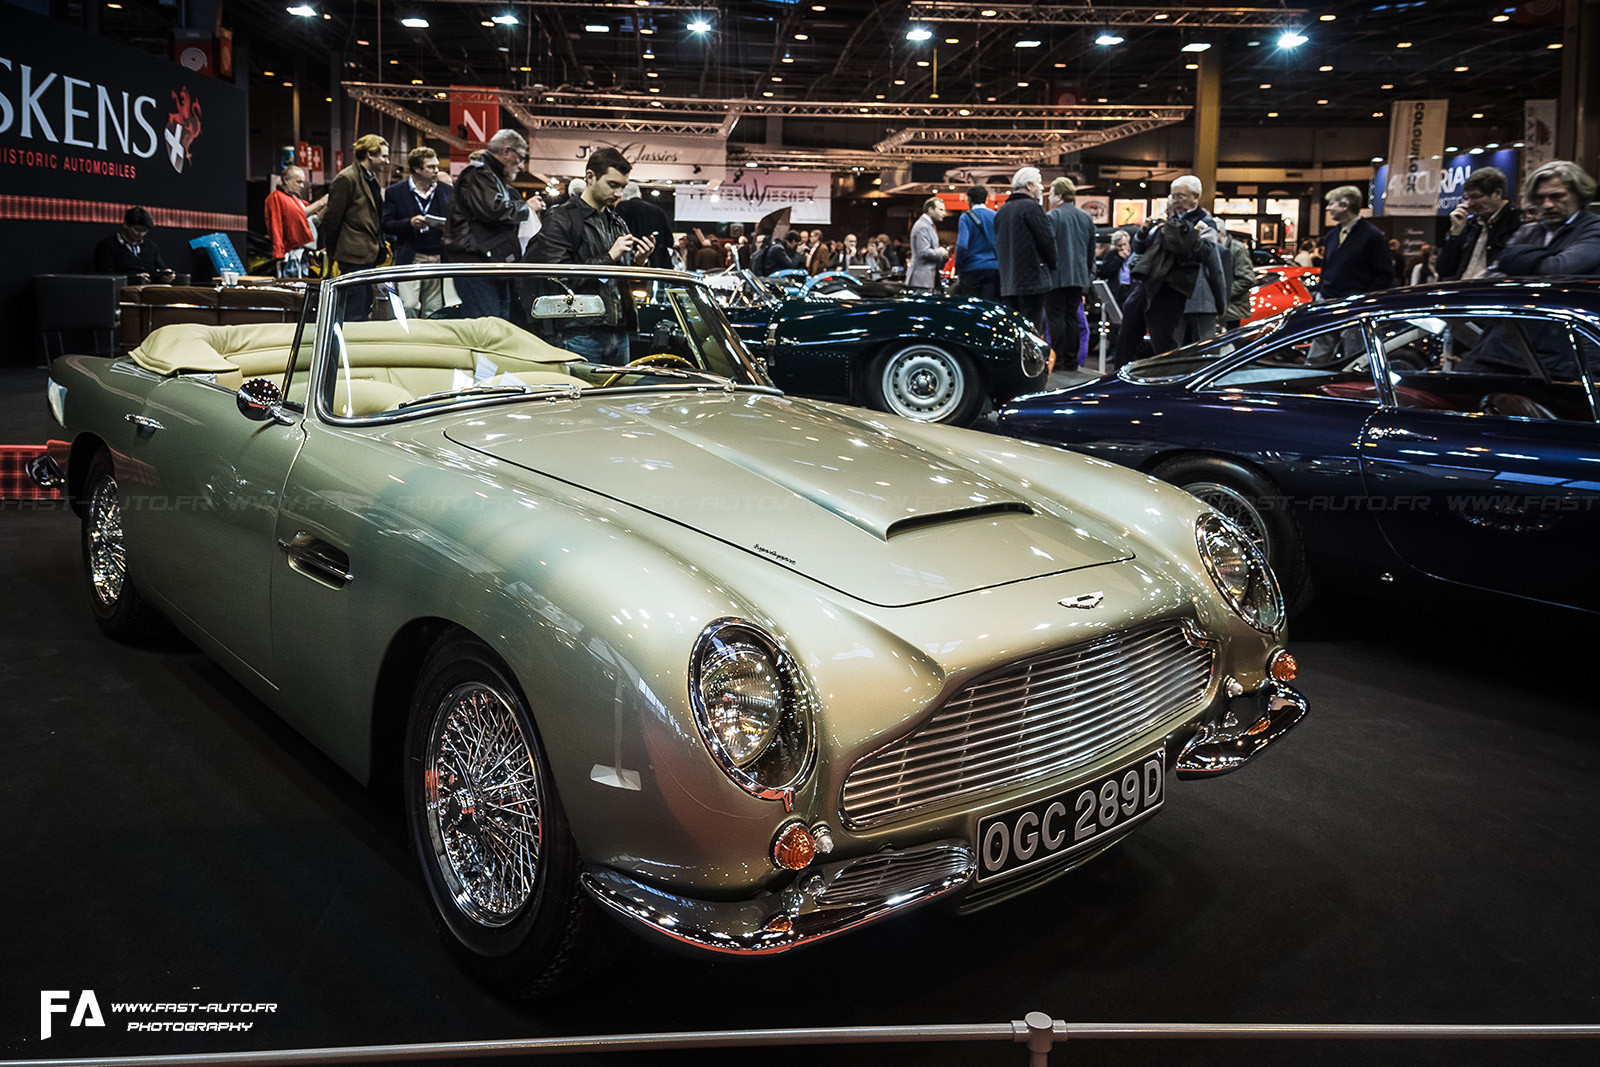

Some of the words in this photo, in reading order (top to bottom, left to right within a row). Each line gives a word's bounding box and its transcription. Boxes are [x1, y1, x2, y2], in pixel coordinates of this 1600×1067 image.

[464, 109, 486, 142] N
[0, 148, 57, 169] ISTORIC
[63, 156, 136, 179] AUTOMOBILES
[983, 801, 1066, 872] OGC
[1074, 759, 1162, 841] 289D
